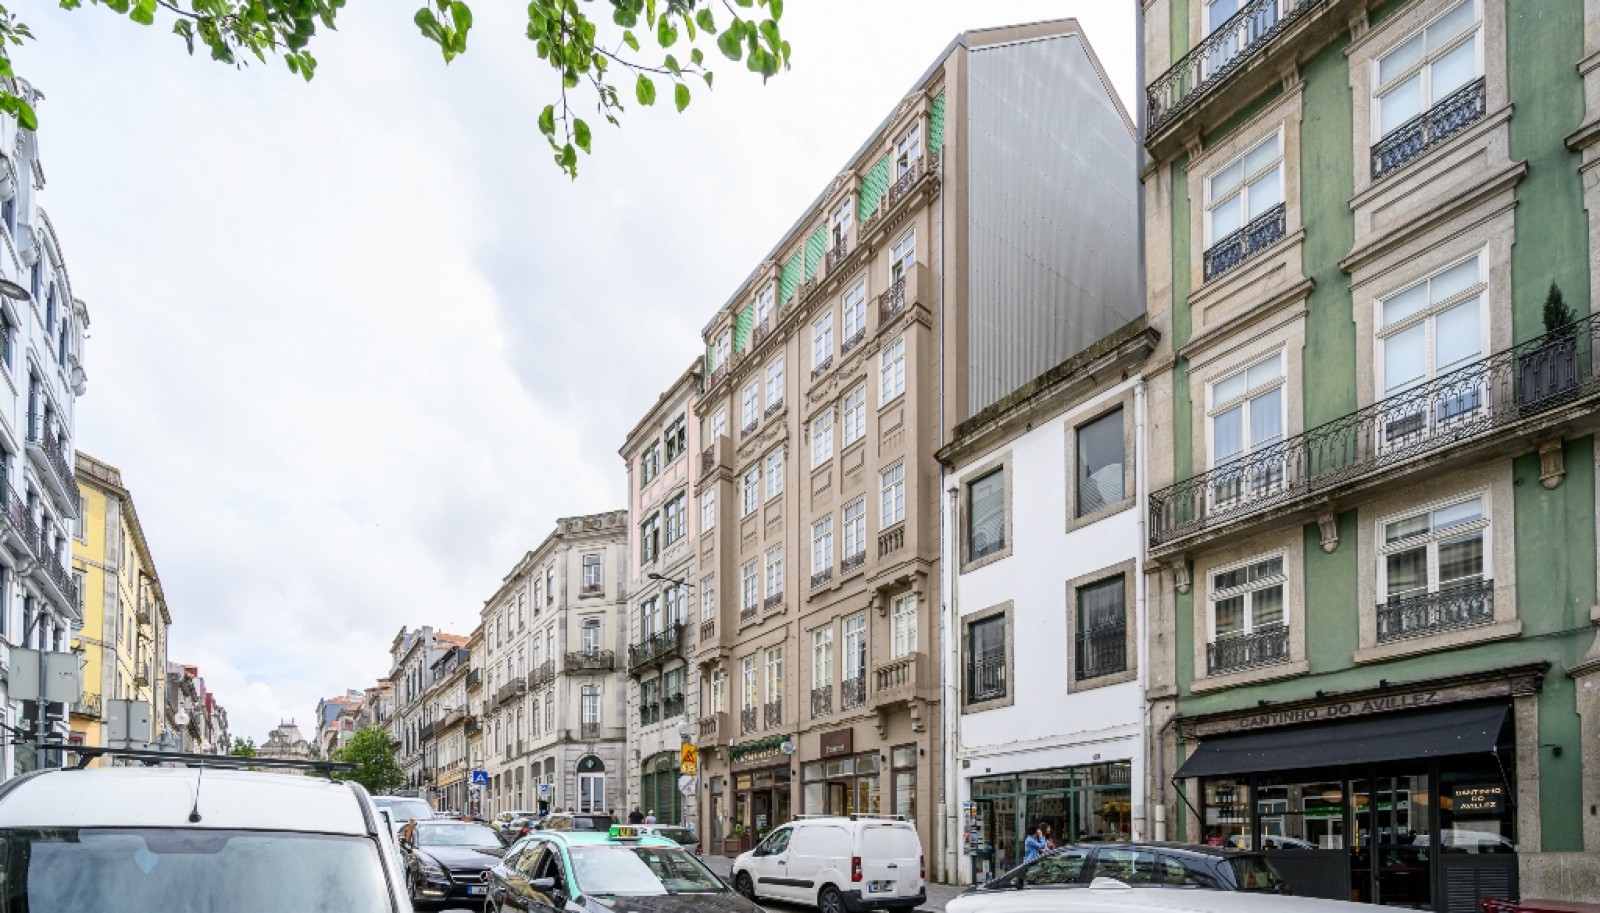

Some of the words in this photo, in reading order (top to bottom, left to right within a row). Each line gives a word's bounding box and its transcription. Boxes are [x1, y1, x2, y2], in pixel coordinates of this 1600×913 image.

[1240, 709, 1318, 728] CANTINHO
[1327, 703, 1351, 717] DO
[1361, 691, 1438, 713] AVILLEZ
